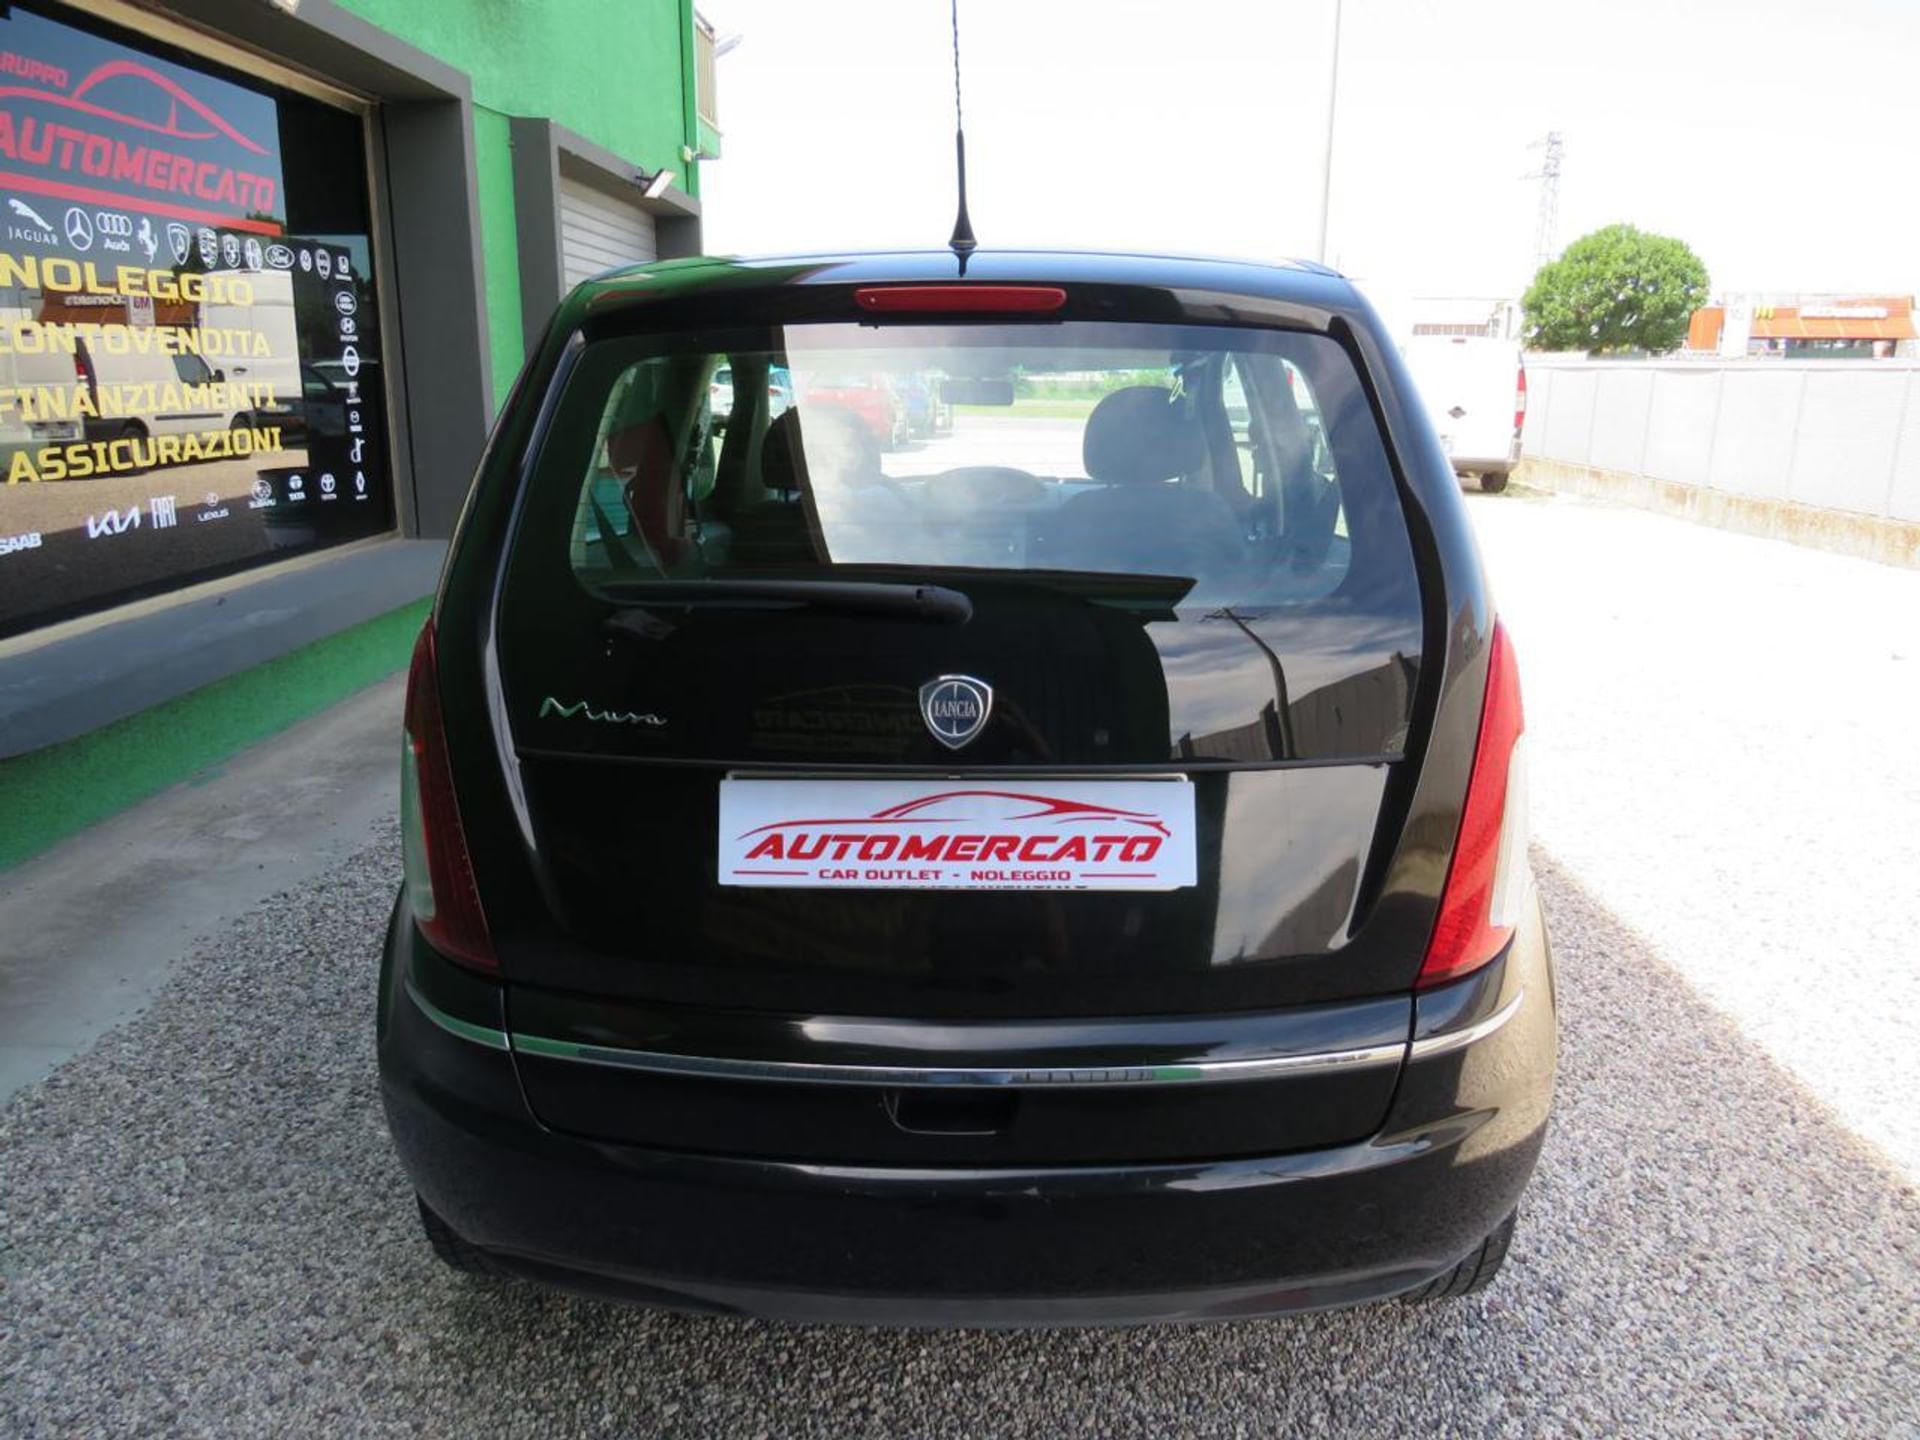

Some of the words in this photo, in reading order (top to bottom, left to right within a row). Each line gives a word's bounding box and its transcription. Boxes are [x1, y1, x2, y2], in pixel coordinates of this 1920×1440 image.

[0, 111, 275, 211] AUTOMERCATO
[8, 226, 59, 246] JAGUAR
[0, 253, 254, 306] NOLEGGIO
[7, 427, 283, 485] ASSICURAZIONI
[151, 495, 177, 529] FIAT
[198, 508, 229, 522] LEXUS
[934, 700, 977, 718] LANCIA
[744, 834, 1164, 863] AUTOMERCATO
[818, 868, 858, 881] CAR
[865, 868, 943, 881] OUTLET
[971, 869, 1071, 882] NOLEGGIO
